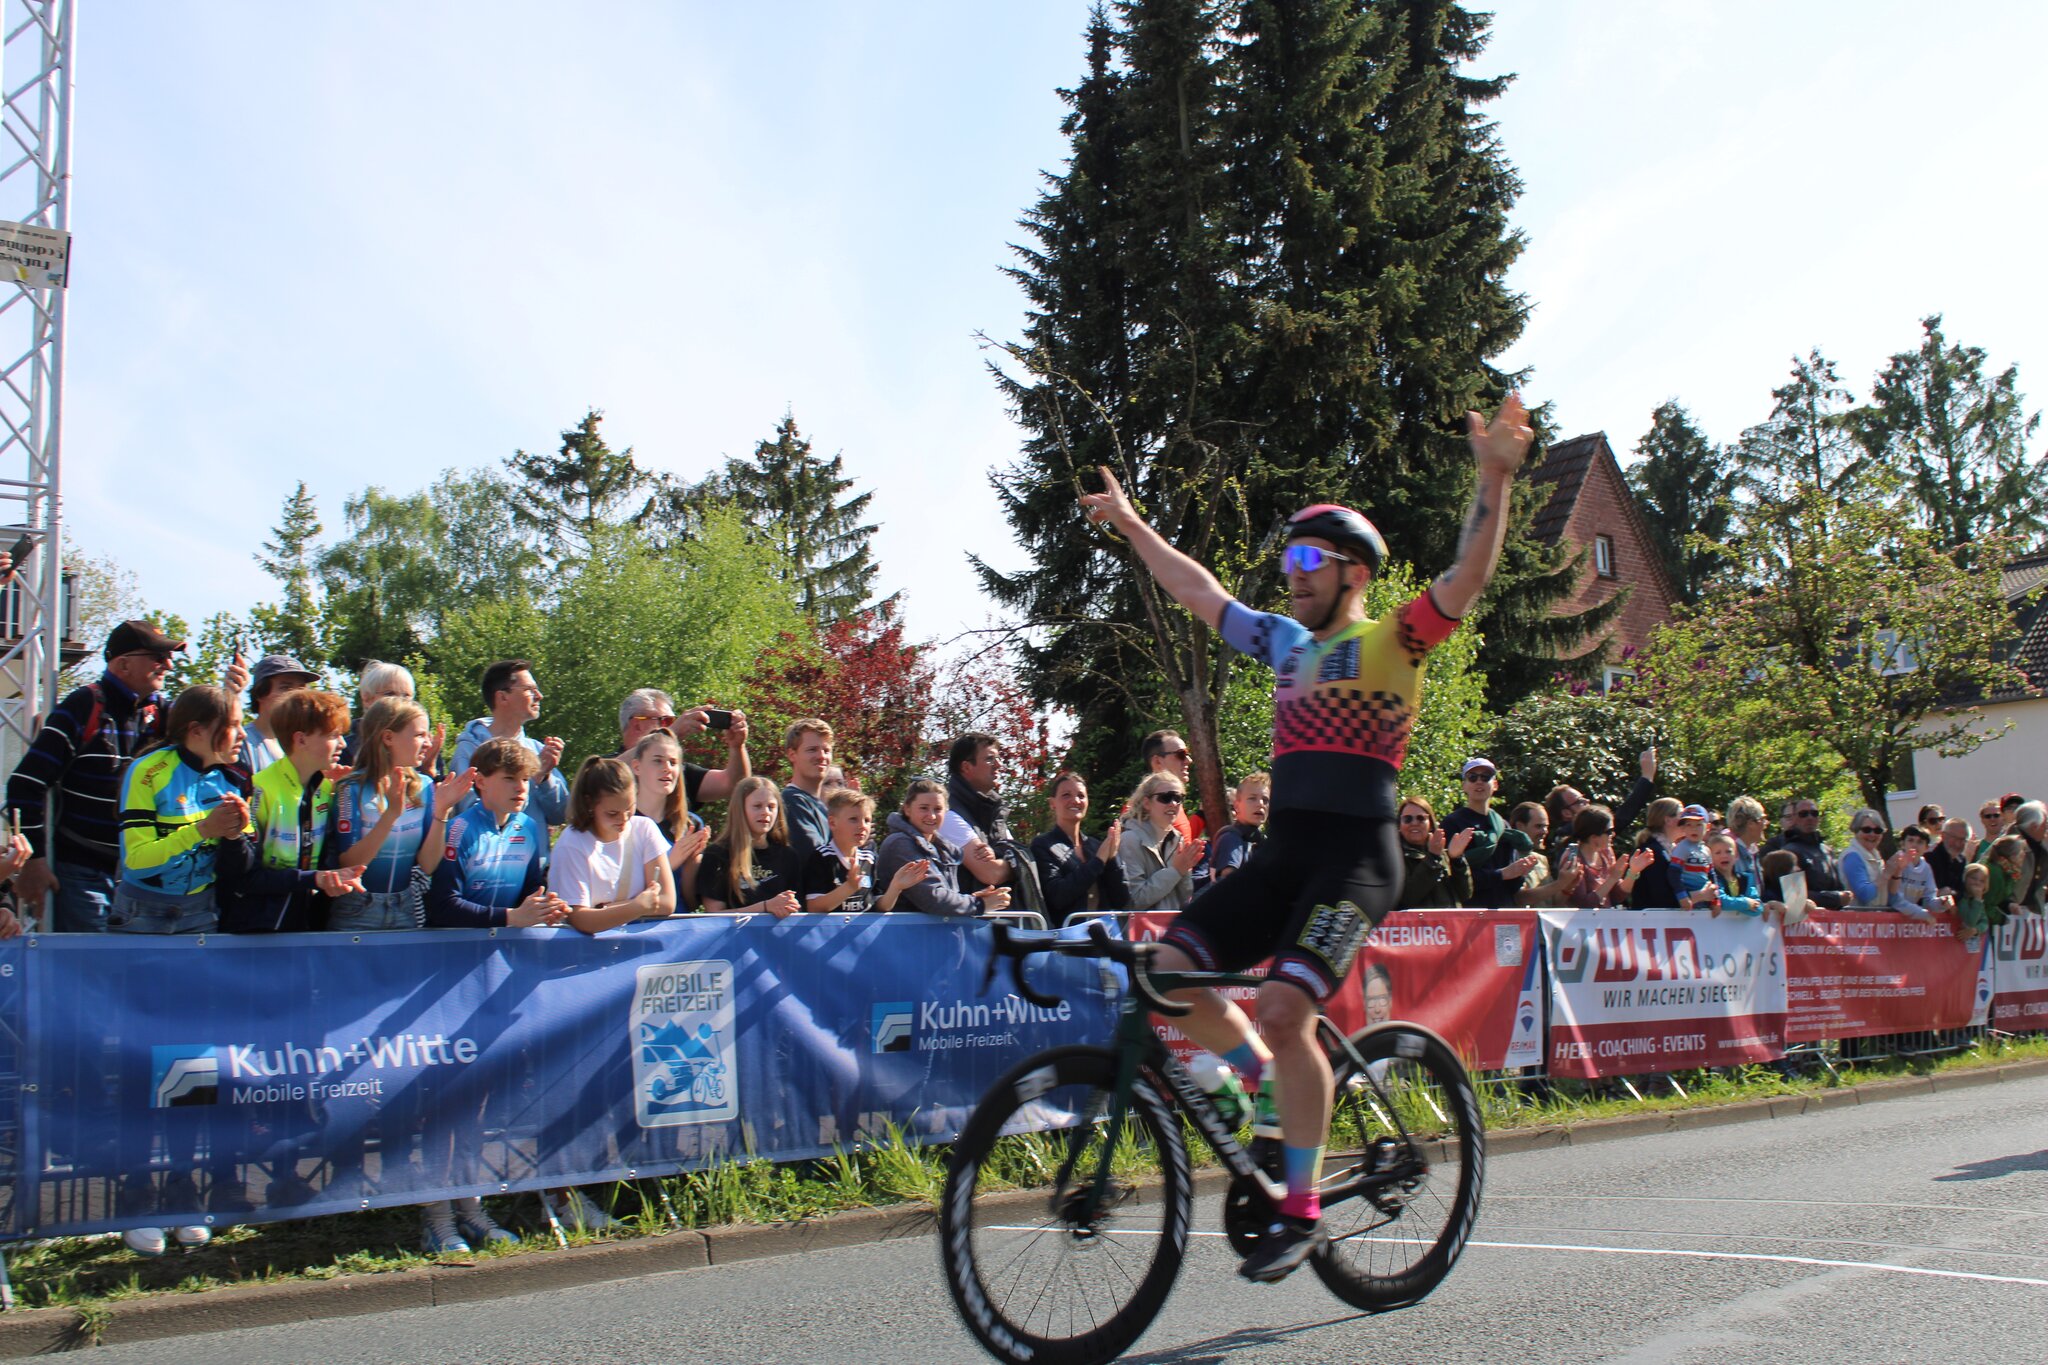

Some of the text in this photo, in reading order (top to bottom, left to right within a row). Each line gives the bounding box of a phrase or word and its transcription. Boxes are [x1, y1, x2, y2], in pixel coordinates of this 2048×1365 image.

[643, 971, 722, 996] MOBILE
[641, 993, 724, 1015] FREIZEIT
[1603, 989, 1632, 1008] WIR
[1638, 986, 1694, 1006] MACHEN
[918, 1031, 1013, 1051] Mobile Freizeit
[1598, 1037, 1656, 1058] COACHING
[1662, 1034, 1706, 1053] EVENTS
[229, 1033, 479, 1078] Kuhn+Witte
[232, 1078, 384, 1105] Mobile Freizeit
